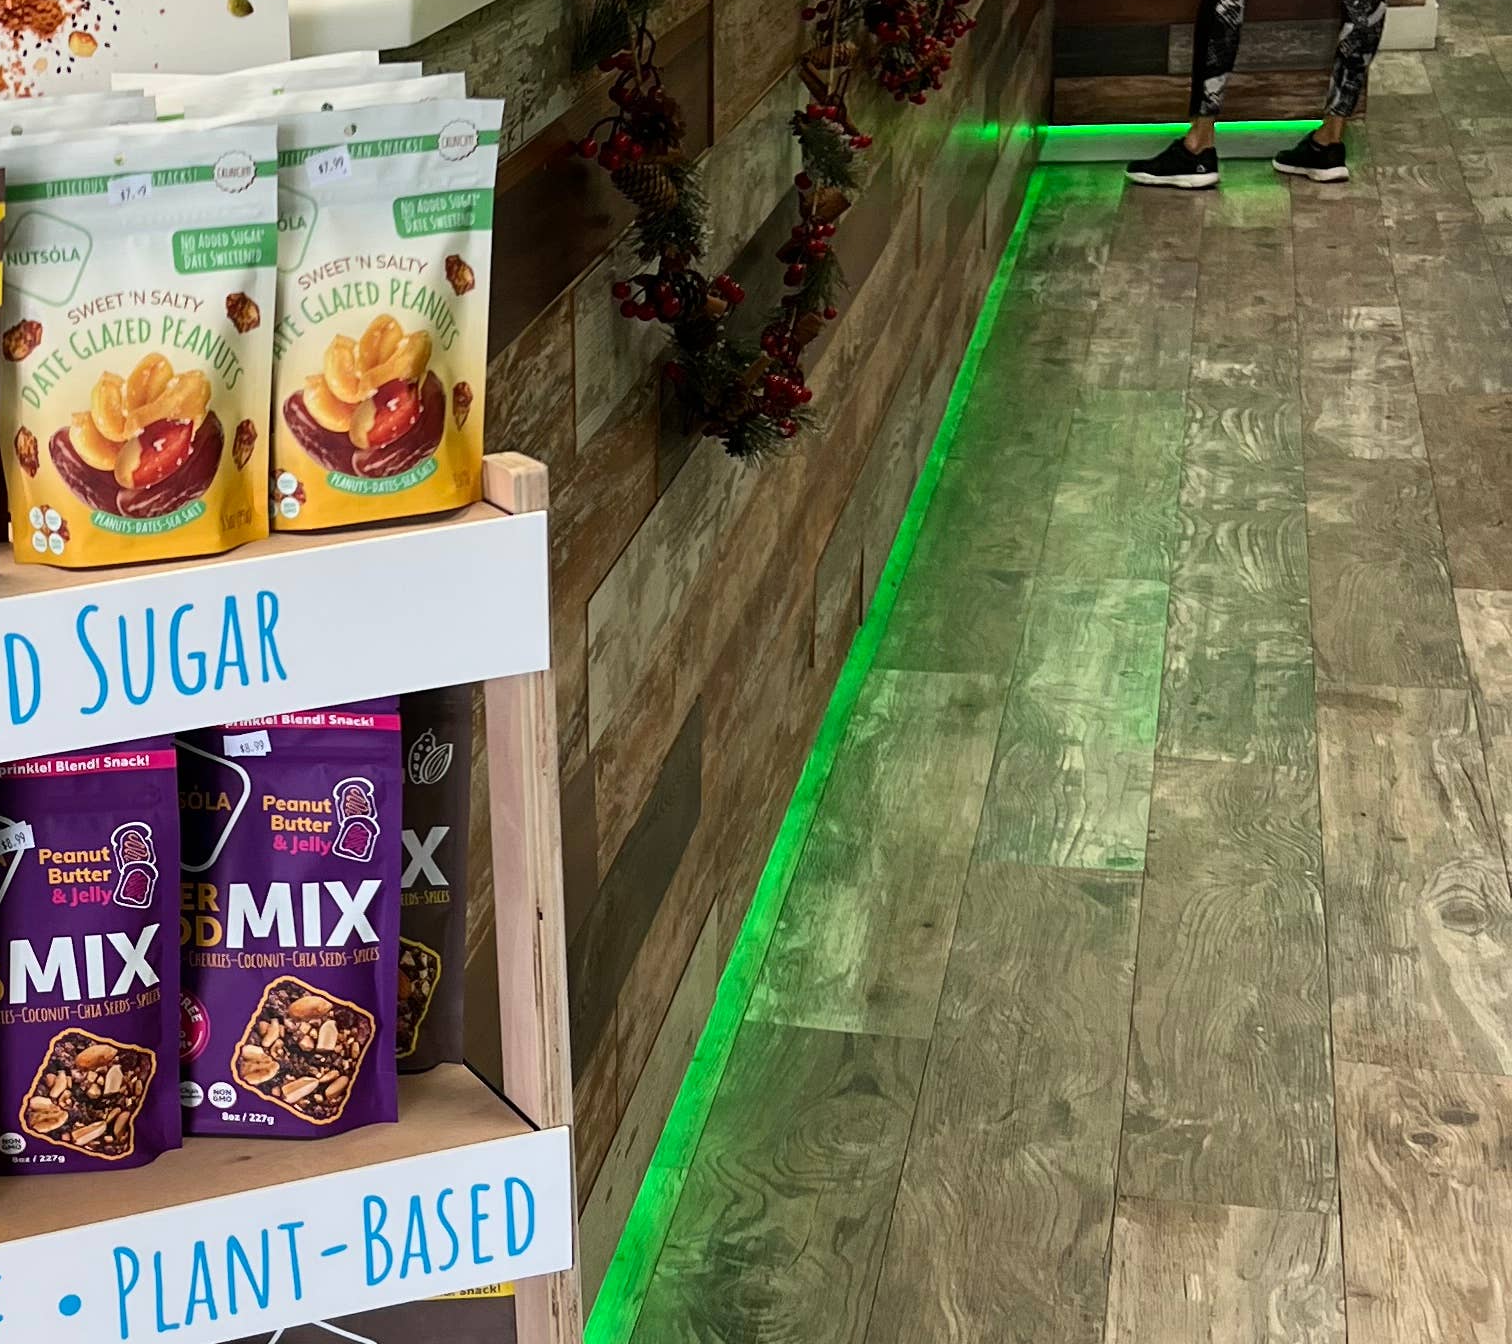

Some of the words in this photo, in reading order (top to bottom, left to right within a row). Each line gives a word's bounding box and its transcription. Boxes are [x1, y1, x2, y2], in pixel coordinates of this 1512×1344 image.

[7, 246, 80, 266] NUTSÓLA
[22, 350, 72, 408] DATE
[69, 317, 151, 360] GLAZED
[161, 315, 244, 390] PEANUTS
[55, 760, 100, 772] Blend!
[103, 754, 149, 768] Snack!
[263, 795, 332, 813] Peanut
[271, 815, 332, 832] Butter
[1, 831, 26, 850] $8.99
[273, 836, 287, 851] &
[290, 836, 332, 855] Jelly
[39, 846, 110, 864] Peanut
[48, 868, 112, 885] Butter
[51, 890, 66, 904] &
[70, 887, 113, 907] Jelly
[226, 879, 382, 949] MIX
[9, 924, 160, 1004] MIX
